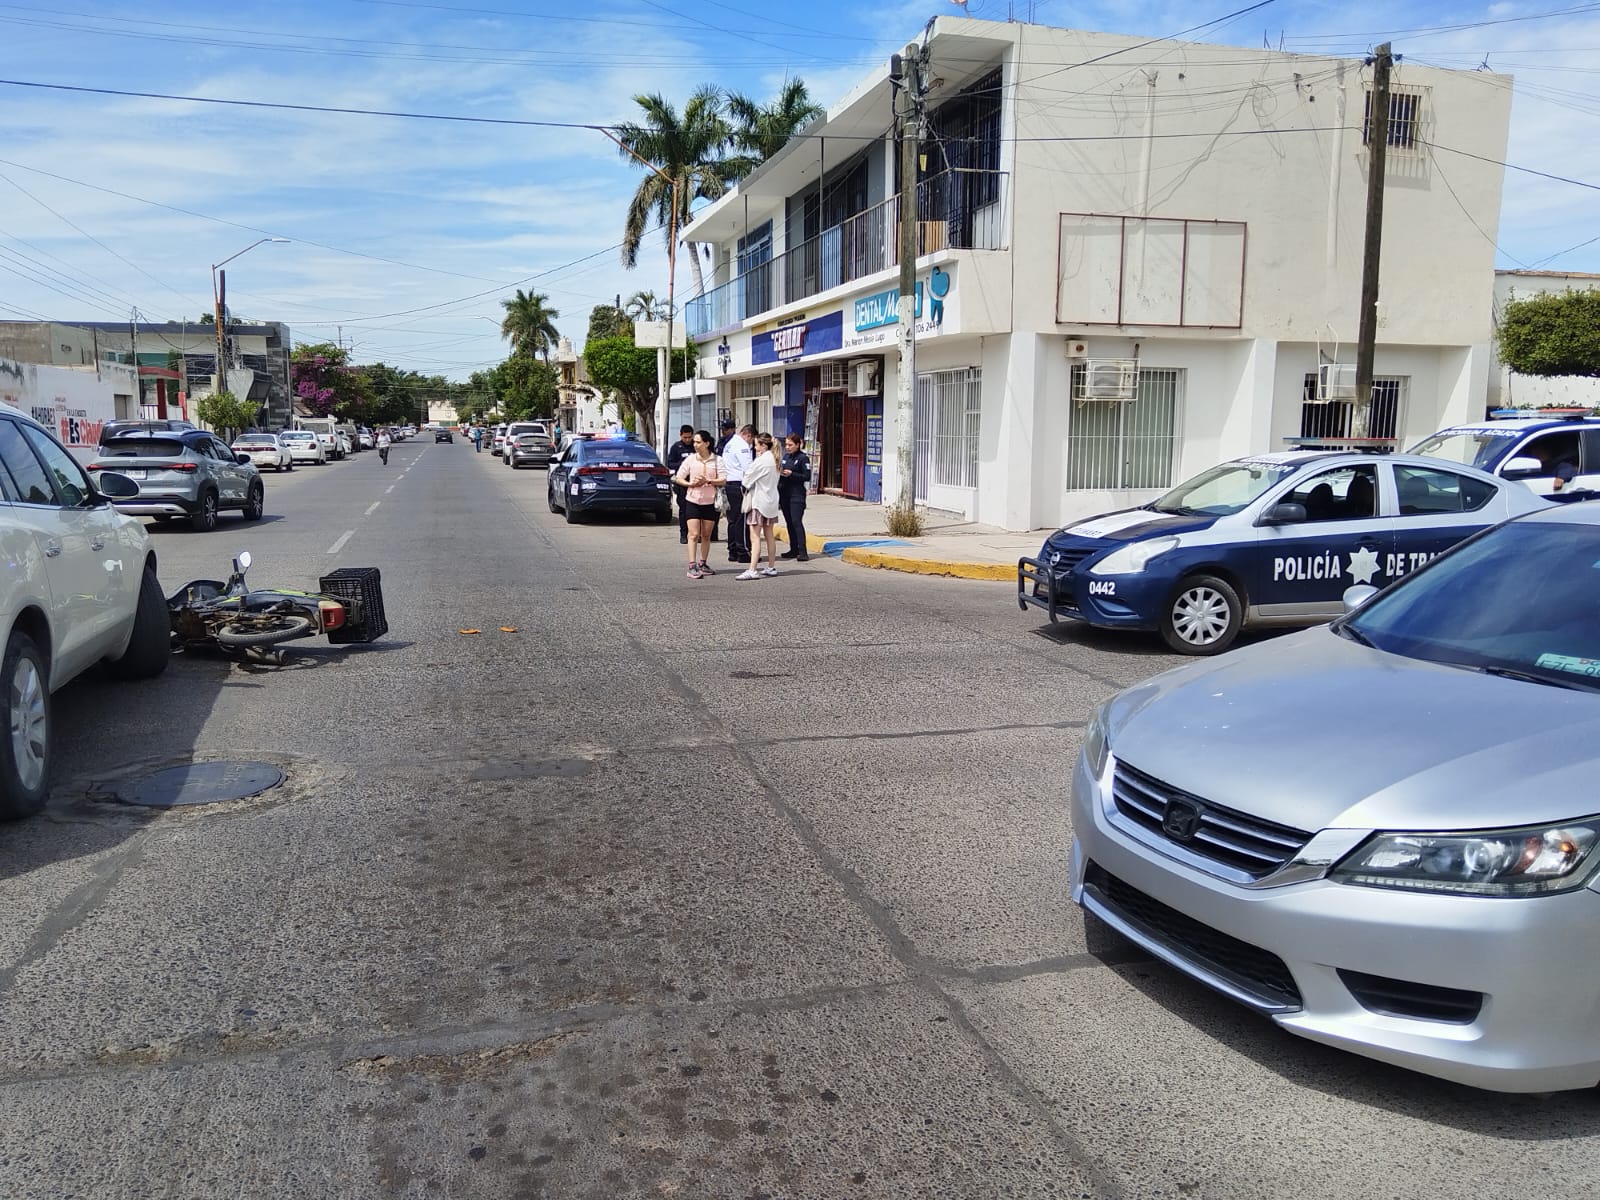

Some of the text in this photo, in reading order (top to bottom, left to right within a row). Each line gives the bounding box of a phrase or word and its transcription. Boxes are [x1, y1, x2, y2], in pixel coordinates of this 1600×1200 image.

[856, 298, 883, 326] DENTAL
[61, 416, 103, 445] #EsClaud
[1273, 549, 1342, 582] POLICÍA
[1385, 553, 1404, 577] DE
[1089, 581, 1116, 595] 0442
